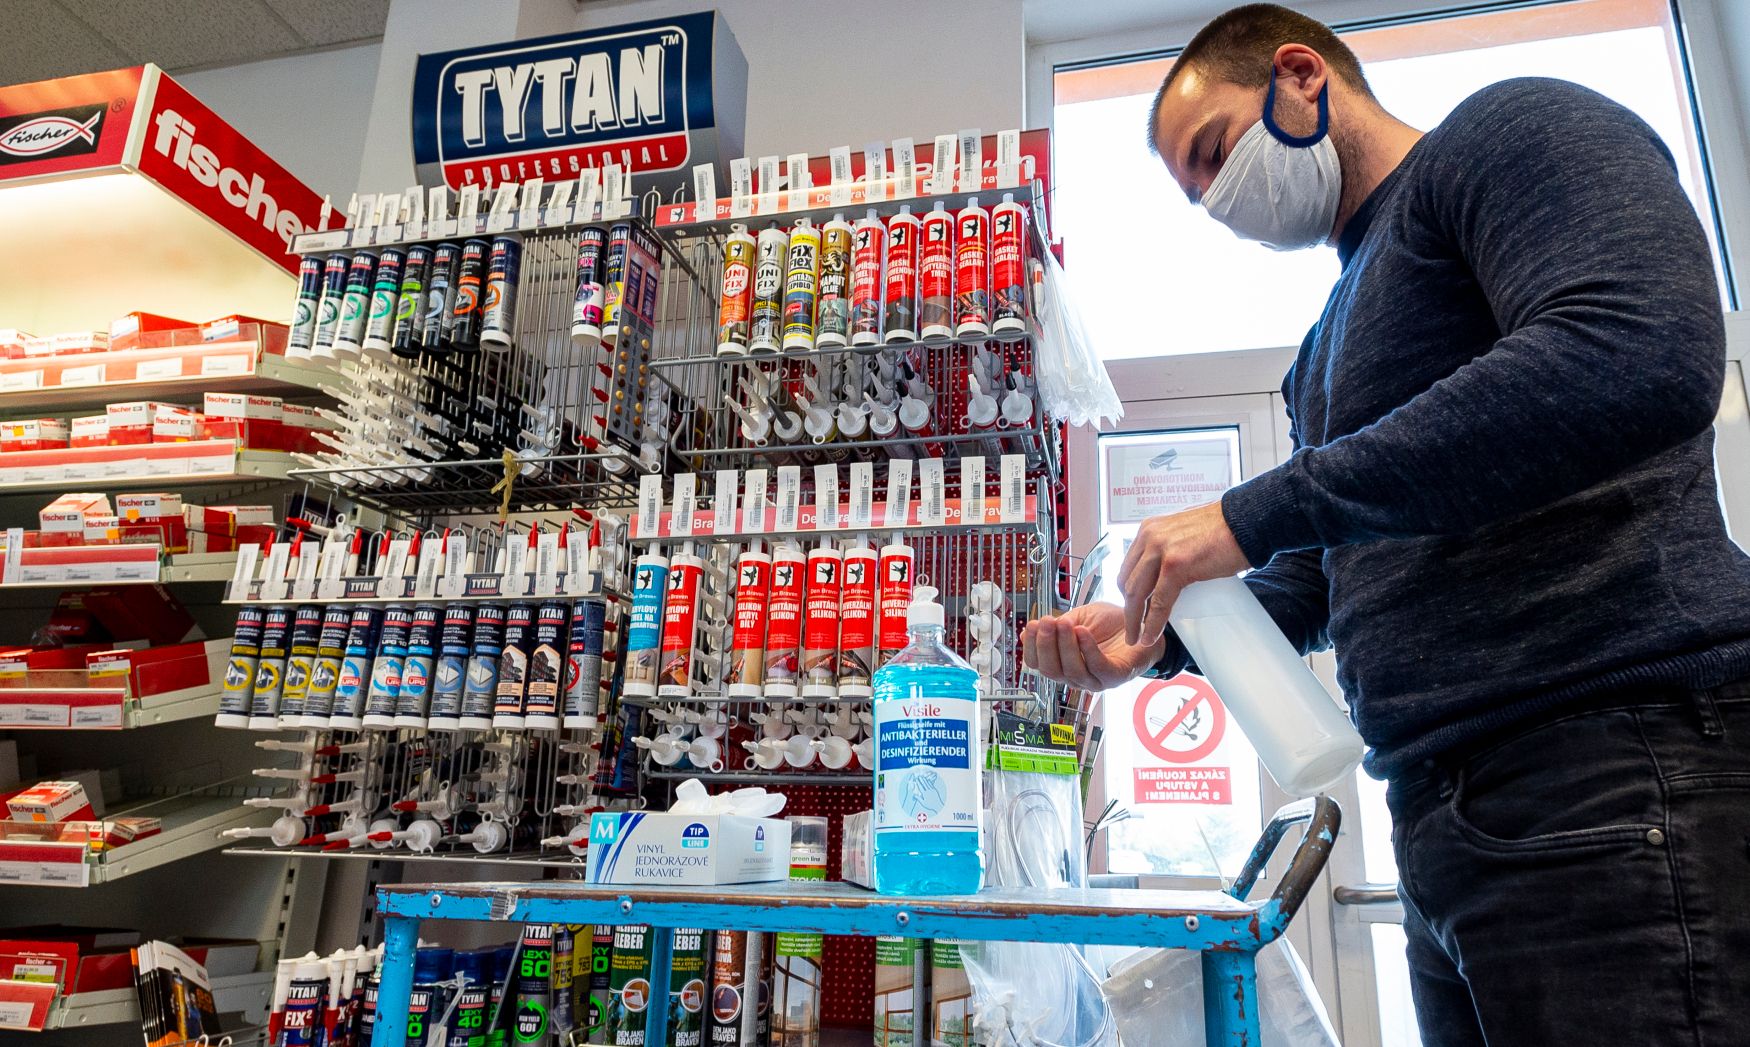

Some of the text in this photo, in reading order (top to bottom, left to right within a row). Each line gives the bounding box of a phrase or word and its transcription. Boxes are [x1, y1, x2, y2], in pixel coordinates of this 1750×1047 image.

[455, 45, 664, 148] TYTAN
[8, 126, 73, 145] fischer
[817, 192, 832, 203] De
[581, 230, 600, 240] YTAN
[612, 229, 627, 240] TAN
[995, 245, 1018, 256] GASKET
[960, 251, 983, 261] GASKET
[994, 254, 1019, 265] SEALANT
[960, 258, 984, 269] SEALANT
[726, 269, 745, 279] UNI
[757, 269, 778, 279] UNI
[931, 269, 947, 278] TMEL
[889, 275, 904, 284] TMEL
[725, 280, 743, 290] FIX
[757, 280, 775, 290] FIX
[822, 286, 839, 294] GLUE
[206, 396, 230, 404] fischer
[248, 397, 272, 406] fischer
[109, 405, 131, 413] fischer
[155, 416, 180, 426] fischer
[118, 498, 143, 507] fischer
[42, 513, 66, 521] fischer
[945, 505, 1003, 520] De rav
[86, 520, 110, 528] fischer
[693, 517, 716, 530] Bra
[801, 513, 817, 526] De
[350, 583, 374, 592] TYTAN
[471, 578, 497, 588] TYTAN
[666, 604, 689, 614] RYLOVÝ
[738, 603, 762, 612] SILIKON
[882, 599, 911, 609] UNIVERZÁ
[386, 612, 412, 623] TYTAN
[414, 611, 435, 621] YTAN
[508, 609, 530, 620] YTAN
[644, 614, 654, 622] NA
[738, 611, 758, 621] AKRYL
[771, 611, 795, 620] SILIKON
[811, 609, 837, 619] SILIKON
[843, 610, 867, 619] SILIKON
[884, 608, 907, 618] SILIKO
[902, 702, 941, 717] Visile
[881, 729, 967, 743] ANTIBAKTERIELLER
[1052, 726, 1075, 743] NOVINKA
[881, 746, 967, 759] DESINFIZIERENDER
[907, 757, 937, 765] Wirkung
[50, 793, 73, 808] fischer
[10, 804, 33, 813] fischer
[953, 812, 974, 820] 1000 ml
[595, 822, 613, 839] M
[690, 827, 703, 836] TIP
[637, 844, 665, 854] VINYL
[687, 840, 706, 848] LINE
[635, 854, 708, 866] JEDNORÁZOVÉ
[635, 868, 684, 878] RUKAVICE
[593, 925, 611, 936] TAN
[557, 941, 572, 950] TYTAN
[673, 935, 701, 950] LEBER
[523, 950, 549, 959] LEXY
[26, 957, 45, 965] fischer
[593, 957, 609, 973] 0
[521, 959, 549, 977] 60
[579, 961, 591, 972] 753
[554, 968, 572, 985] 753
[409, 993, 427, 1005] TAN
[461, 992, 485, 1003] TYTAN
[459, 1008, 482, 1016] LEXY
[409, 1014, 422, 1022] XY
[458, 1016, 482, 1028] 40
[407, 1022, 422, 1037] 0
[617, 1030, 644, 1039] DEN JAKO
[676, 1031, 688, 1040] DEN
[616, 1037, 644, 1046] BRAVEN
[675, 1038, 700, 1046] BRAVEN
